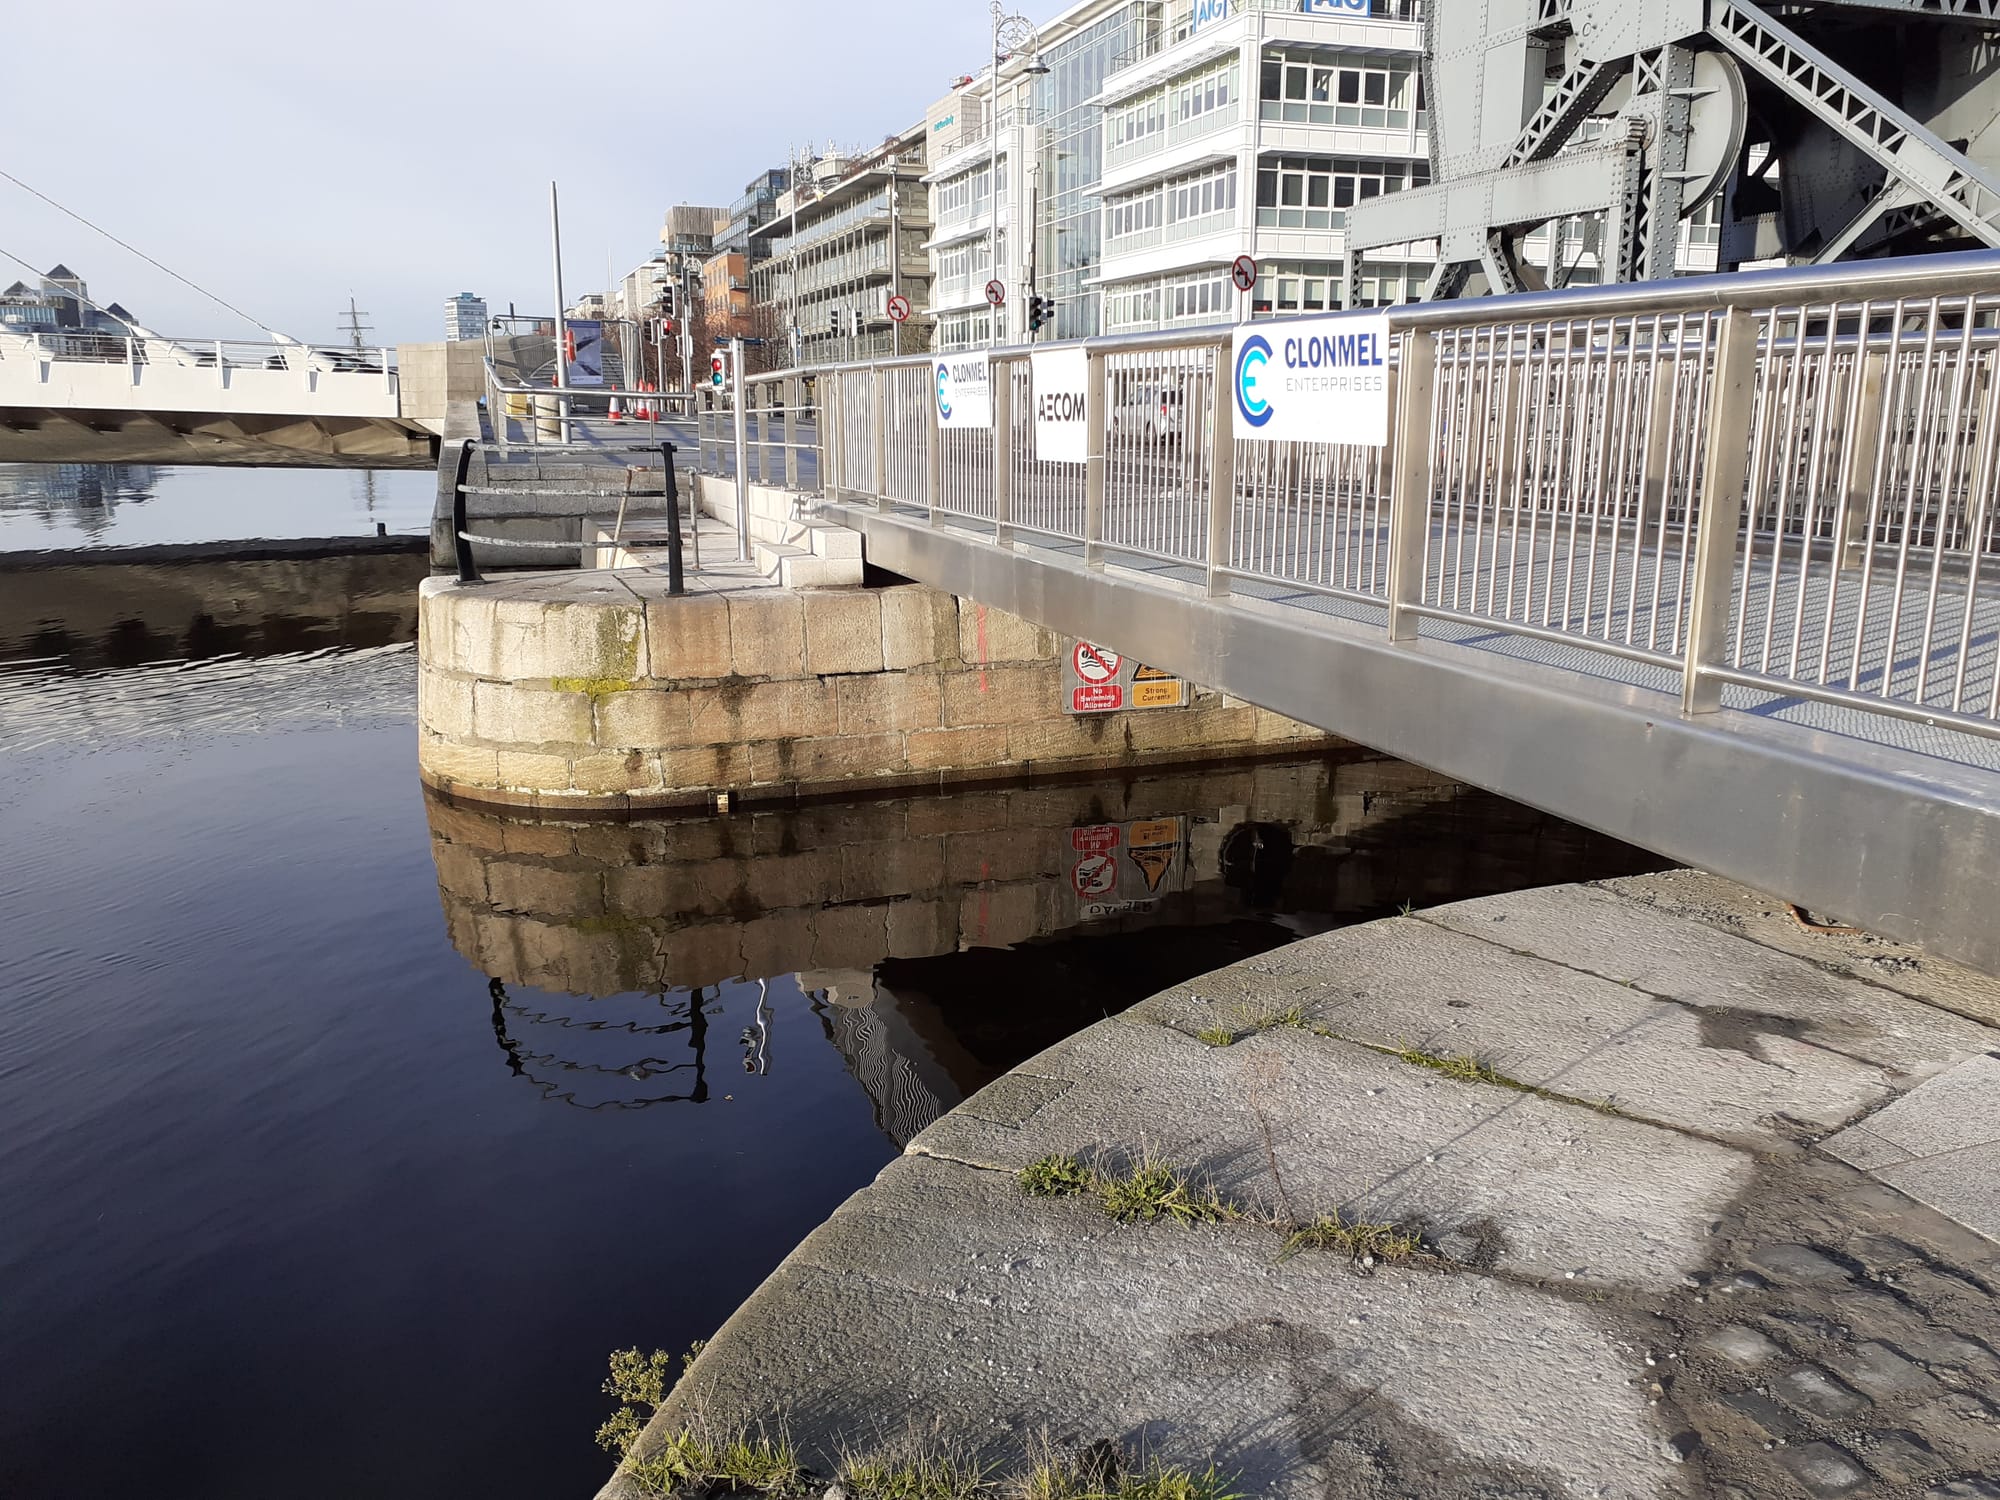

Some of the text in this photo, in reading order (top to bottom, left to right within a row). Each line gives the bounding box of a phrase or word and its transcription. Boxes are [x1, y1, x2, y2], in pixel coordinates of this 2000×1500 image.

[1284, 333, 1383, 369] CLONMEL
[952, 361, 987, 383] CLONMEL
[1286, 376, 1383, 392] ENTERPRISES
[1038, 392, 1085, 422] AECOM
[1092, 687, 1103, 695] No
[1145, 687, 1168, 695] Strong
[1080, 694, 1115, 703] Swimming
[1083, 701, 1112, 709] Allowed
